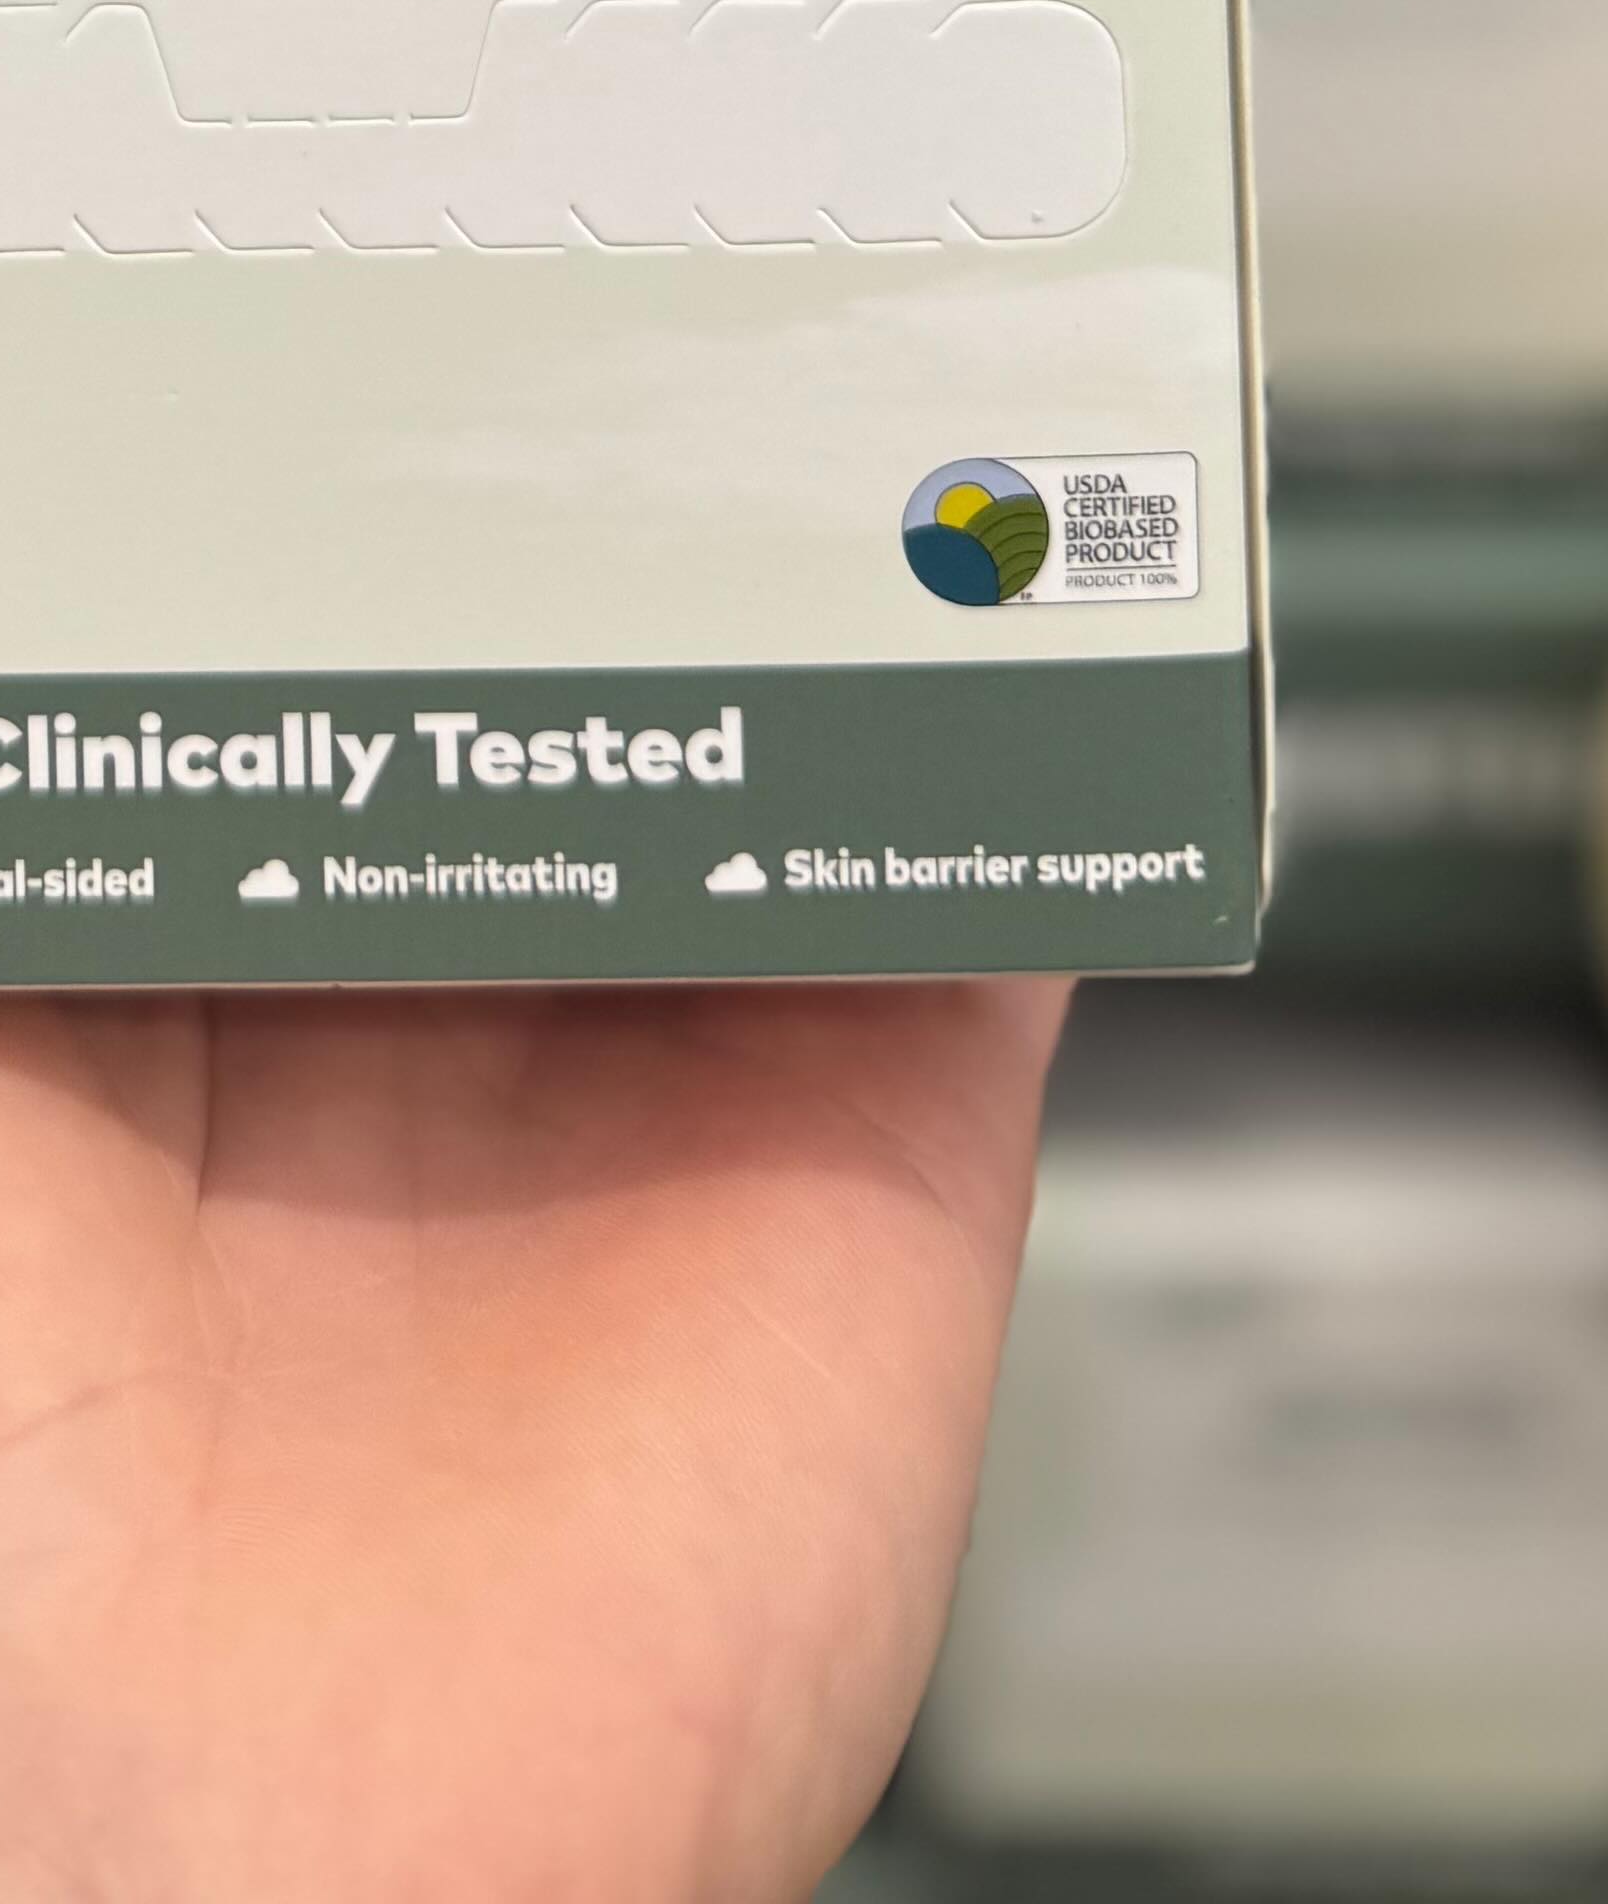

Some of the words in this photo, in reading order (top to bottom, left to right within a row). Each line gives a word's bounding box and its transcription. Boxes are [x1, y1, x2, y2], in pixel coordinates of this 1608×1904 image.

[1063, 474, 1128, 495] USDA
[1063, 495, 1177, 518] CERTIFIED
[1064, 517, 1180, 541] BIOBASED
[1065, 540, 1177, 563] PRODUCT
[1065, 573, 1136, 589] PRODUCT
[1139, 572, 1178, 587] 100%
[413, 705, 745, 788] Tested
[322, 850, 619, 903] Non-irritating
[783, 845, 877, 890] Skin
[883, 843, 1030, 888] barrier
[1036, 840, 1206, 894] support
